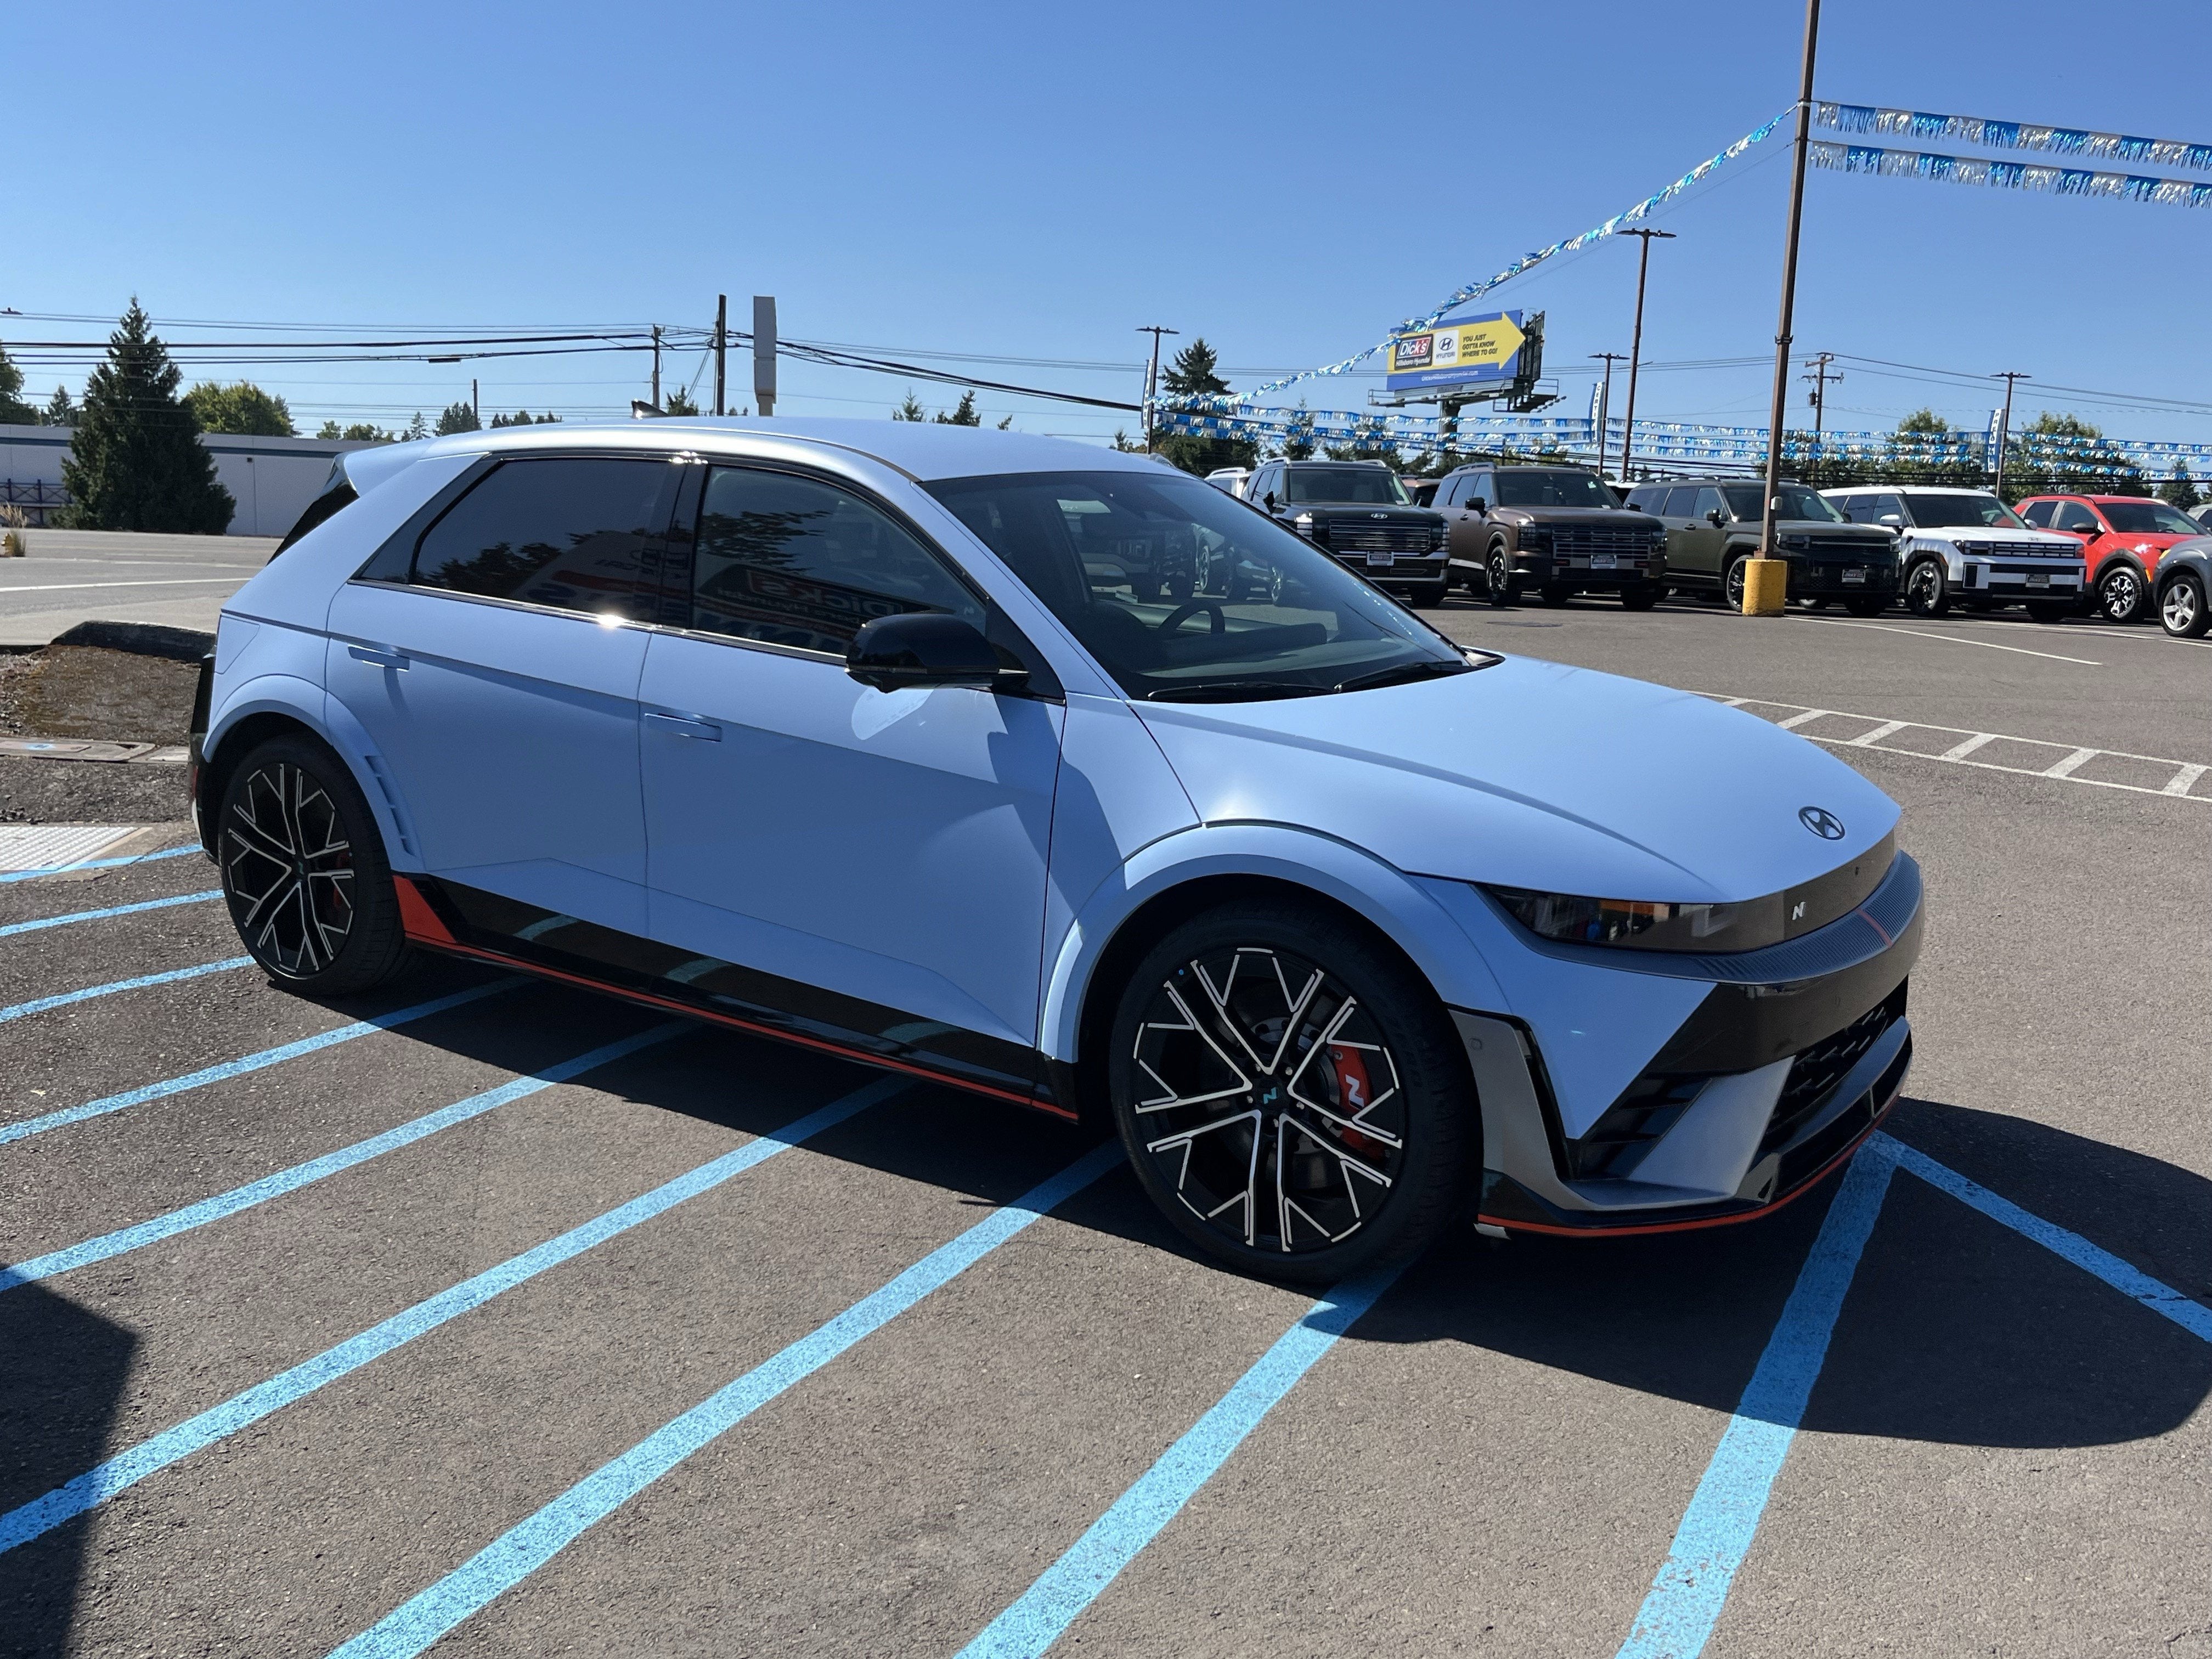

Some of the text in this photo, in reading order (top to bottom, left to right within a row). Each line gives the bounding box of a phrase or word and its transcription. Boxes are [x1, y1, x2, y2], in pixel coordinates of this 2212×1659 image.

[1792, 901, 1807, 921] N
[1263, 1087, 1280, 1104] N
[1345, 1075, 1364, 1110] N
